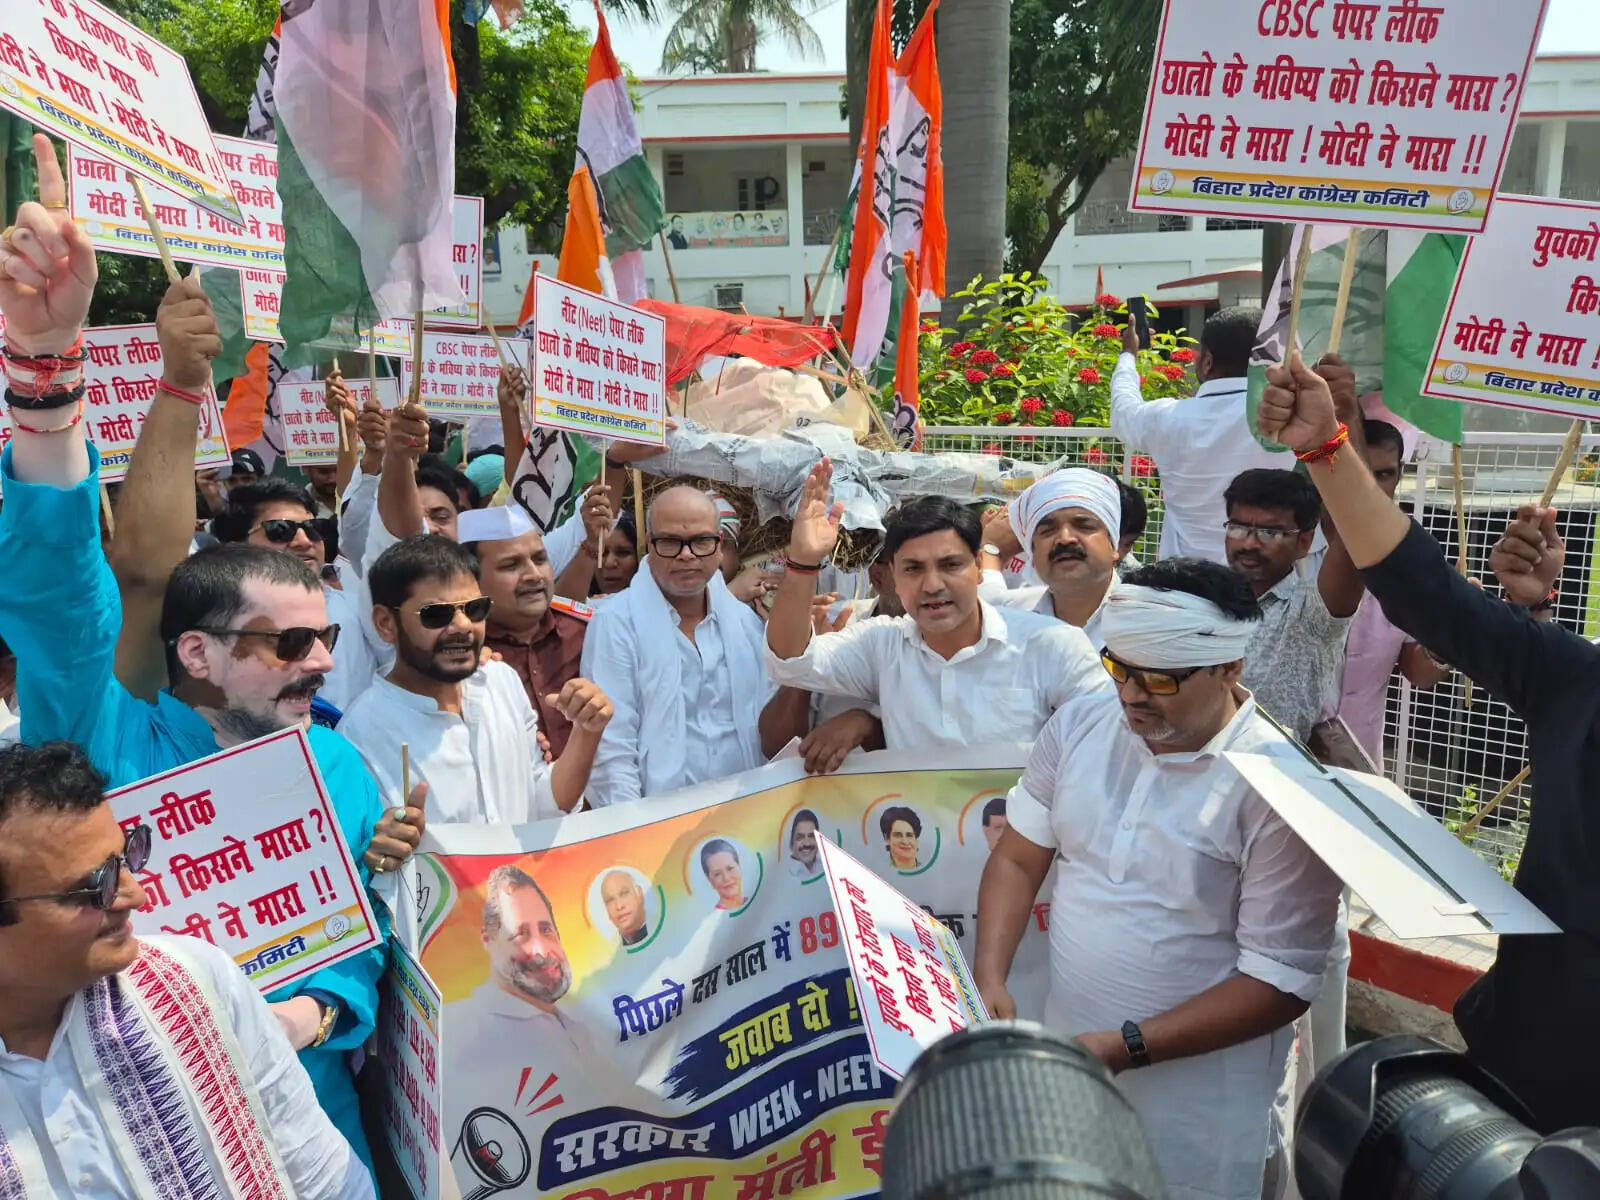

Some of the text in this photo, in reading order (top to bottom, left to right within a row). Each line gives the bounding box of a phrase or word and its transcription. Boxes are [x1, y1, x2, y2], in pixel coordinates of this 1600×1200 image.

[1257, 0, 1324, 39] CBSC
[1384, 0, 1445, 43] लीक
[43, 18, 143, 103] किसने मारा
[131, 41, 159, 77] को
[1161, 51, 1217, 96] छात्रो
[1222, 52, 1248, 98] के
[1253, 54, 1325, 102] भविष्य
[1329, 58, 1364, 104] को
[1368, 59, 1441, 109] किसने
[1446, 74, 1499, 112] मारा
[28, 46, 54, 91] ने
[52, 68, 98, 114] मारा
[111, 98, 154, 146] मोदी
[150, 118, 172, 156] ने
[169, 136, 206, 174] मारा
[36, 96, 83, 132] बिहार
[83, 122, 121, 151] प्रदेश
[1164, 112, 1216, 158] मोदी
[1220, 115, 1241, 159] ने
[1246, 126, 1294, 162] मारा
[1318, 120, 1374, 167] मोदी
[1378, 124, 1401, 168] ने
[1405, 135, 1457, 172] मारा
[86, 188, 127, 217] मोदी
[152, 204, 187, 228] मारा
[247, 214, 261, 239] ने
[1192, 176, 1430, 208] बिहार प्रदेश कांग्रेस कमिटी
[561, 296, 645, 345] नीट (Neet) पेपर लीक
[1453, 315, 1506, 356] मोदी
[1510, 321, 1532, 359] ने
[1536, 333, 1587, 367] मारा
[86, 341, 120, 367] पेपर
[428, 359, 436, 374] के
[466, 362, 476, 377] को
[436, 341, 458, 356] CBSC
[461, 341, 477, 356] पेपर
[562, 333, 573, 359] के
[575, 337, 601, 367] भविष्य
[602, 345, 614, 371] को
[616, 348, 639, 377] किसने
[641, 360, 657, 382] मारा
[87, 378, 110, 405] को
[431, 380, 438, 395] ने
[441, 383, 457, 396] मारा
[467, 382, 485, 398] मोदी
[544, 365, 563, 393] मोदी
[566, 369, 574, 396] ने
[576, 377, 594, 400] मारा
[604, 379, 622, 407] मोदी
[624, 384, 632, 409] ने
[633, 391, 649, 412] मारा
[1485, 371, 1537, 392] बिहार
[1540, 380, 1585, 399] प्रदेश
[97, 413, 136, 442] मोदी
[556, 404, 647, 431] बिहार प्रदेश कांग्रेस कमिटी
[149, 790, 216, 841] लीक
[169, 835, 255, 898] किसने
[254, 818, 311, 862] मारा
[217, 901, 249, 941] ने
[248, 881, 306, 927] मारा
[840, 877, 867, 905] को
[850, 899, 884, 957] रोजगार
[911, 917, 936, 952] मारा
[613, 978, 685, 1042] पिछले
[692, 963, 722, 1004] दस
[726, 940, 767, 986] साल
[772, 921, 792, 962] में
[860, 952, 888, 978] के
[890, 931, 936, 1024] किसने मारा
[919, 949, 943, 969] ने
[924, 963, 958, 1005] मोदी
[719, 1002, 792, 1071] जवाब
[798, 981, 831, 1032] दो
[553, 1119, 715, 1174] सरकार
[728, 1080, 802, 1150] WEEK
[817, 1054, 883, 1103] NEET
